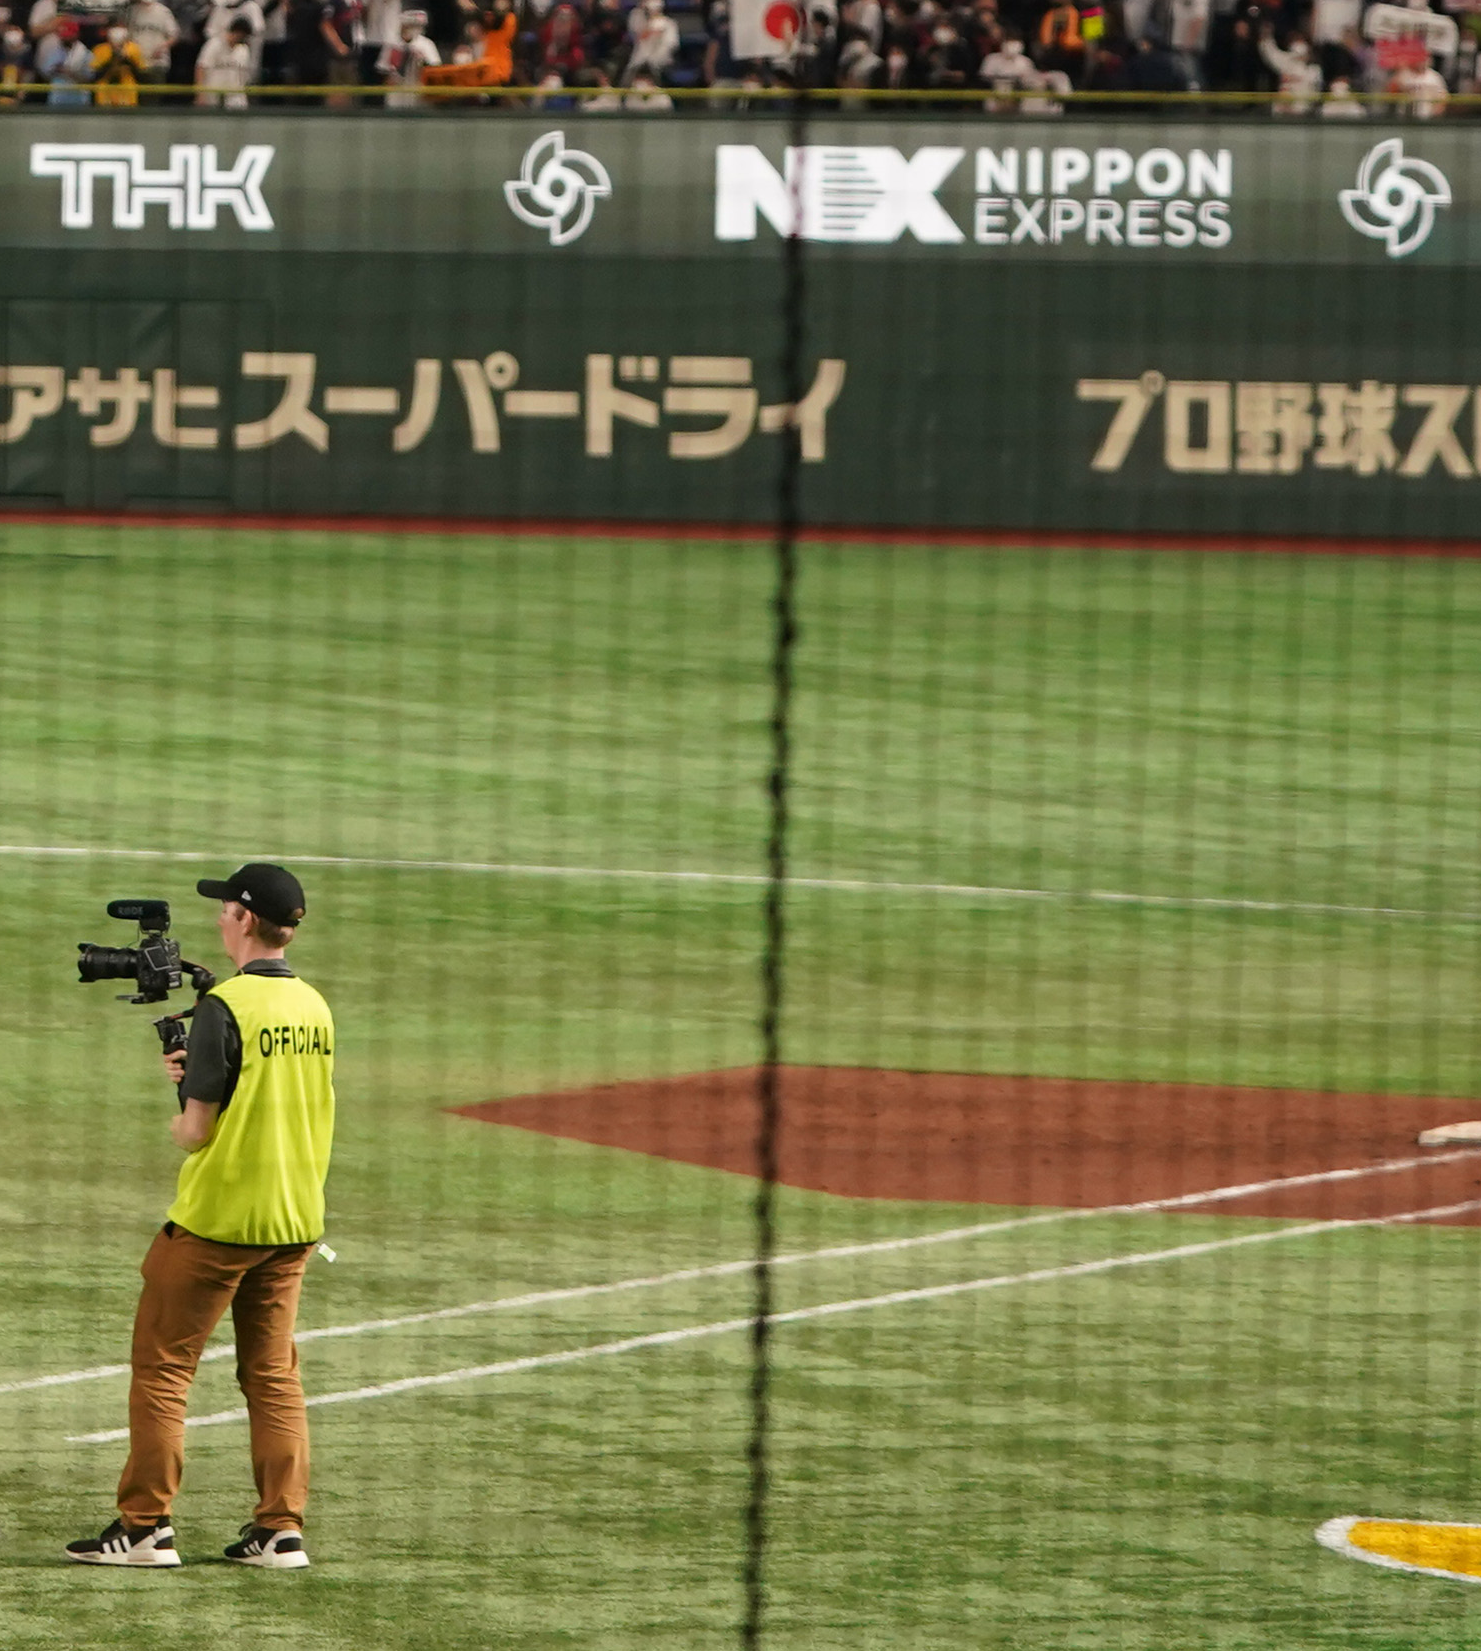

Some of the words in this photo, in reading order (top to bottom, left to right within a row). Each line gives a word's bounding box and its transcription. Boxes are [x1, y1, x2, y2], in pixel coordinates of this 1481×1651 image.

[31, 142, 276, 231] THK
[974, 147, 1233, 196] NIPPON
[974, 198, 1233, 247] EXPRESS
[1076, 369, 1481, 478] プロ野球ス
[260, 1026, 331, 1057] OFFICIAL
